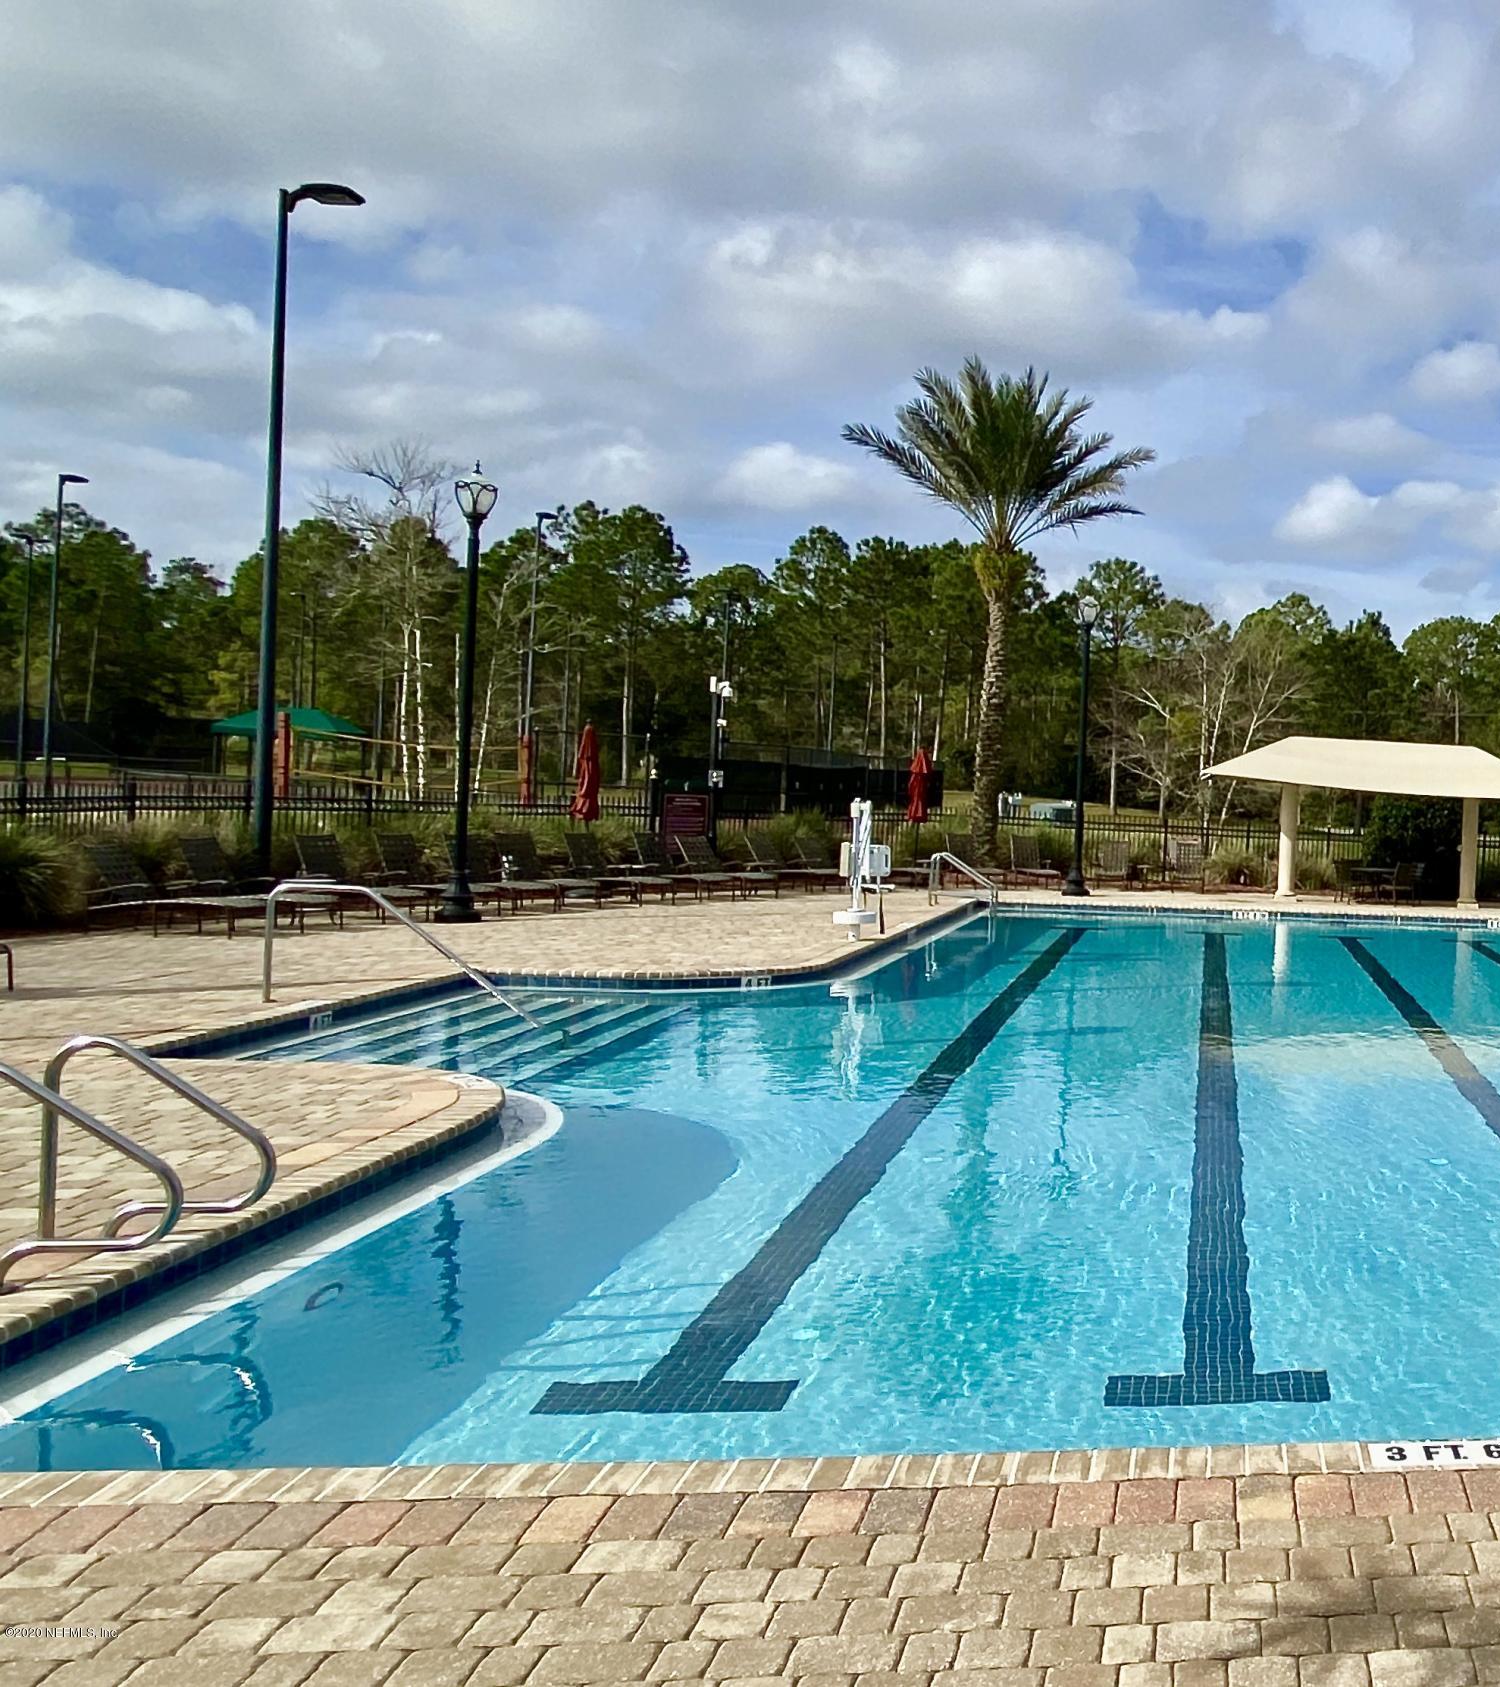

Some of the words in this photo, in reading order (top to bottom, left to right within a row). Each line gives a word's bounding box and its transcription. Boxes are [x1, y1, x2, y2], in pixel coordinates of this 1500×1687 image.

[757, 978, 769, 987] FT
[1385, 1446, 1407, 1461] 3
[1422, 1444, 1469, 1461] FT.
